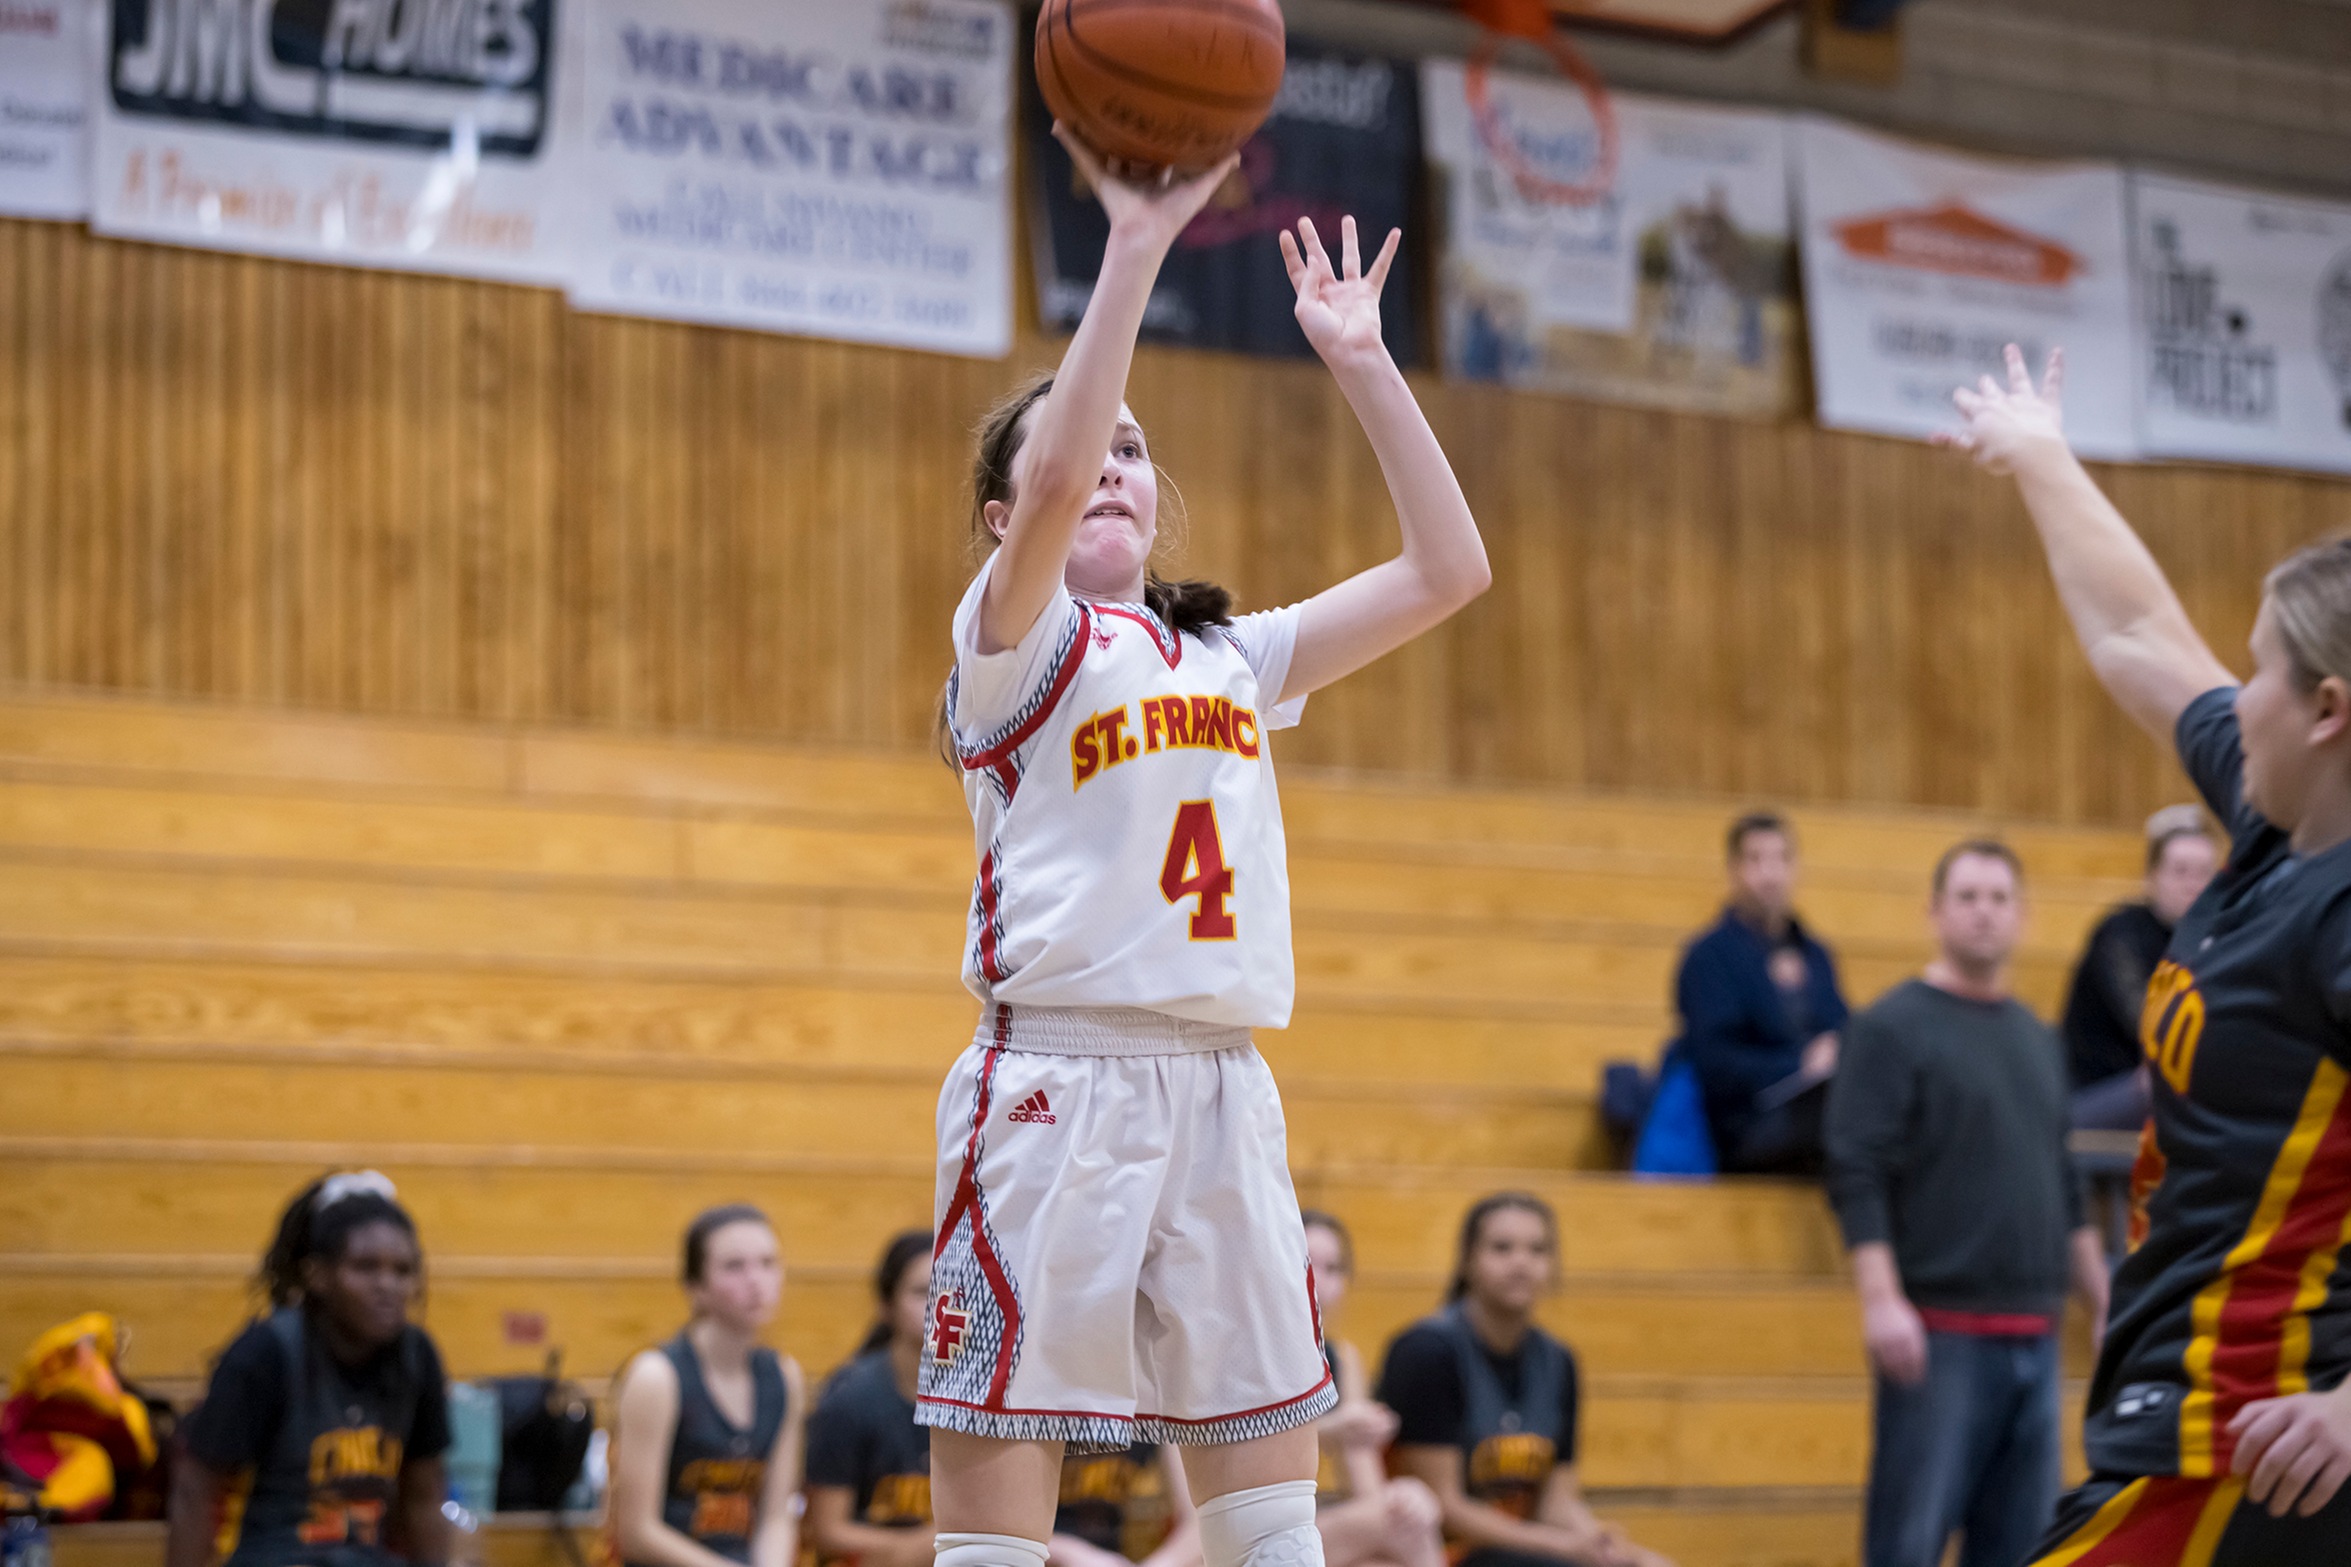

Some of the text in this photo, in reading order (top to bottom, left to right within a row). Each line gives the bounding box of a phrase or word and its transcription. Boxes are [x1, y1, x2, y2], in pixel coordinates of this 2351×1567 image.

[1071, 693, 1260, 794] ST. FRANC
[1159, 798, 1238, 941] 4
[1008, 1109, 1056, 1125] adidas
